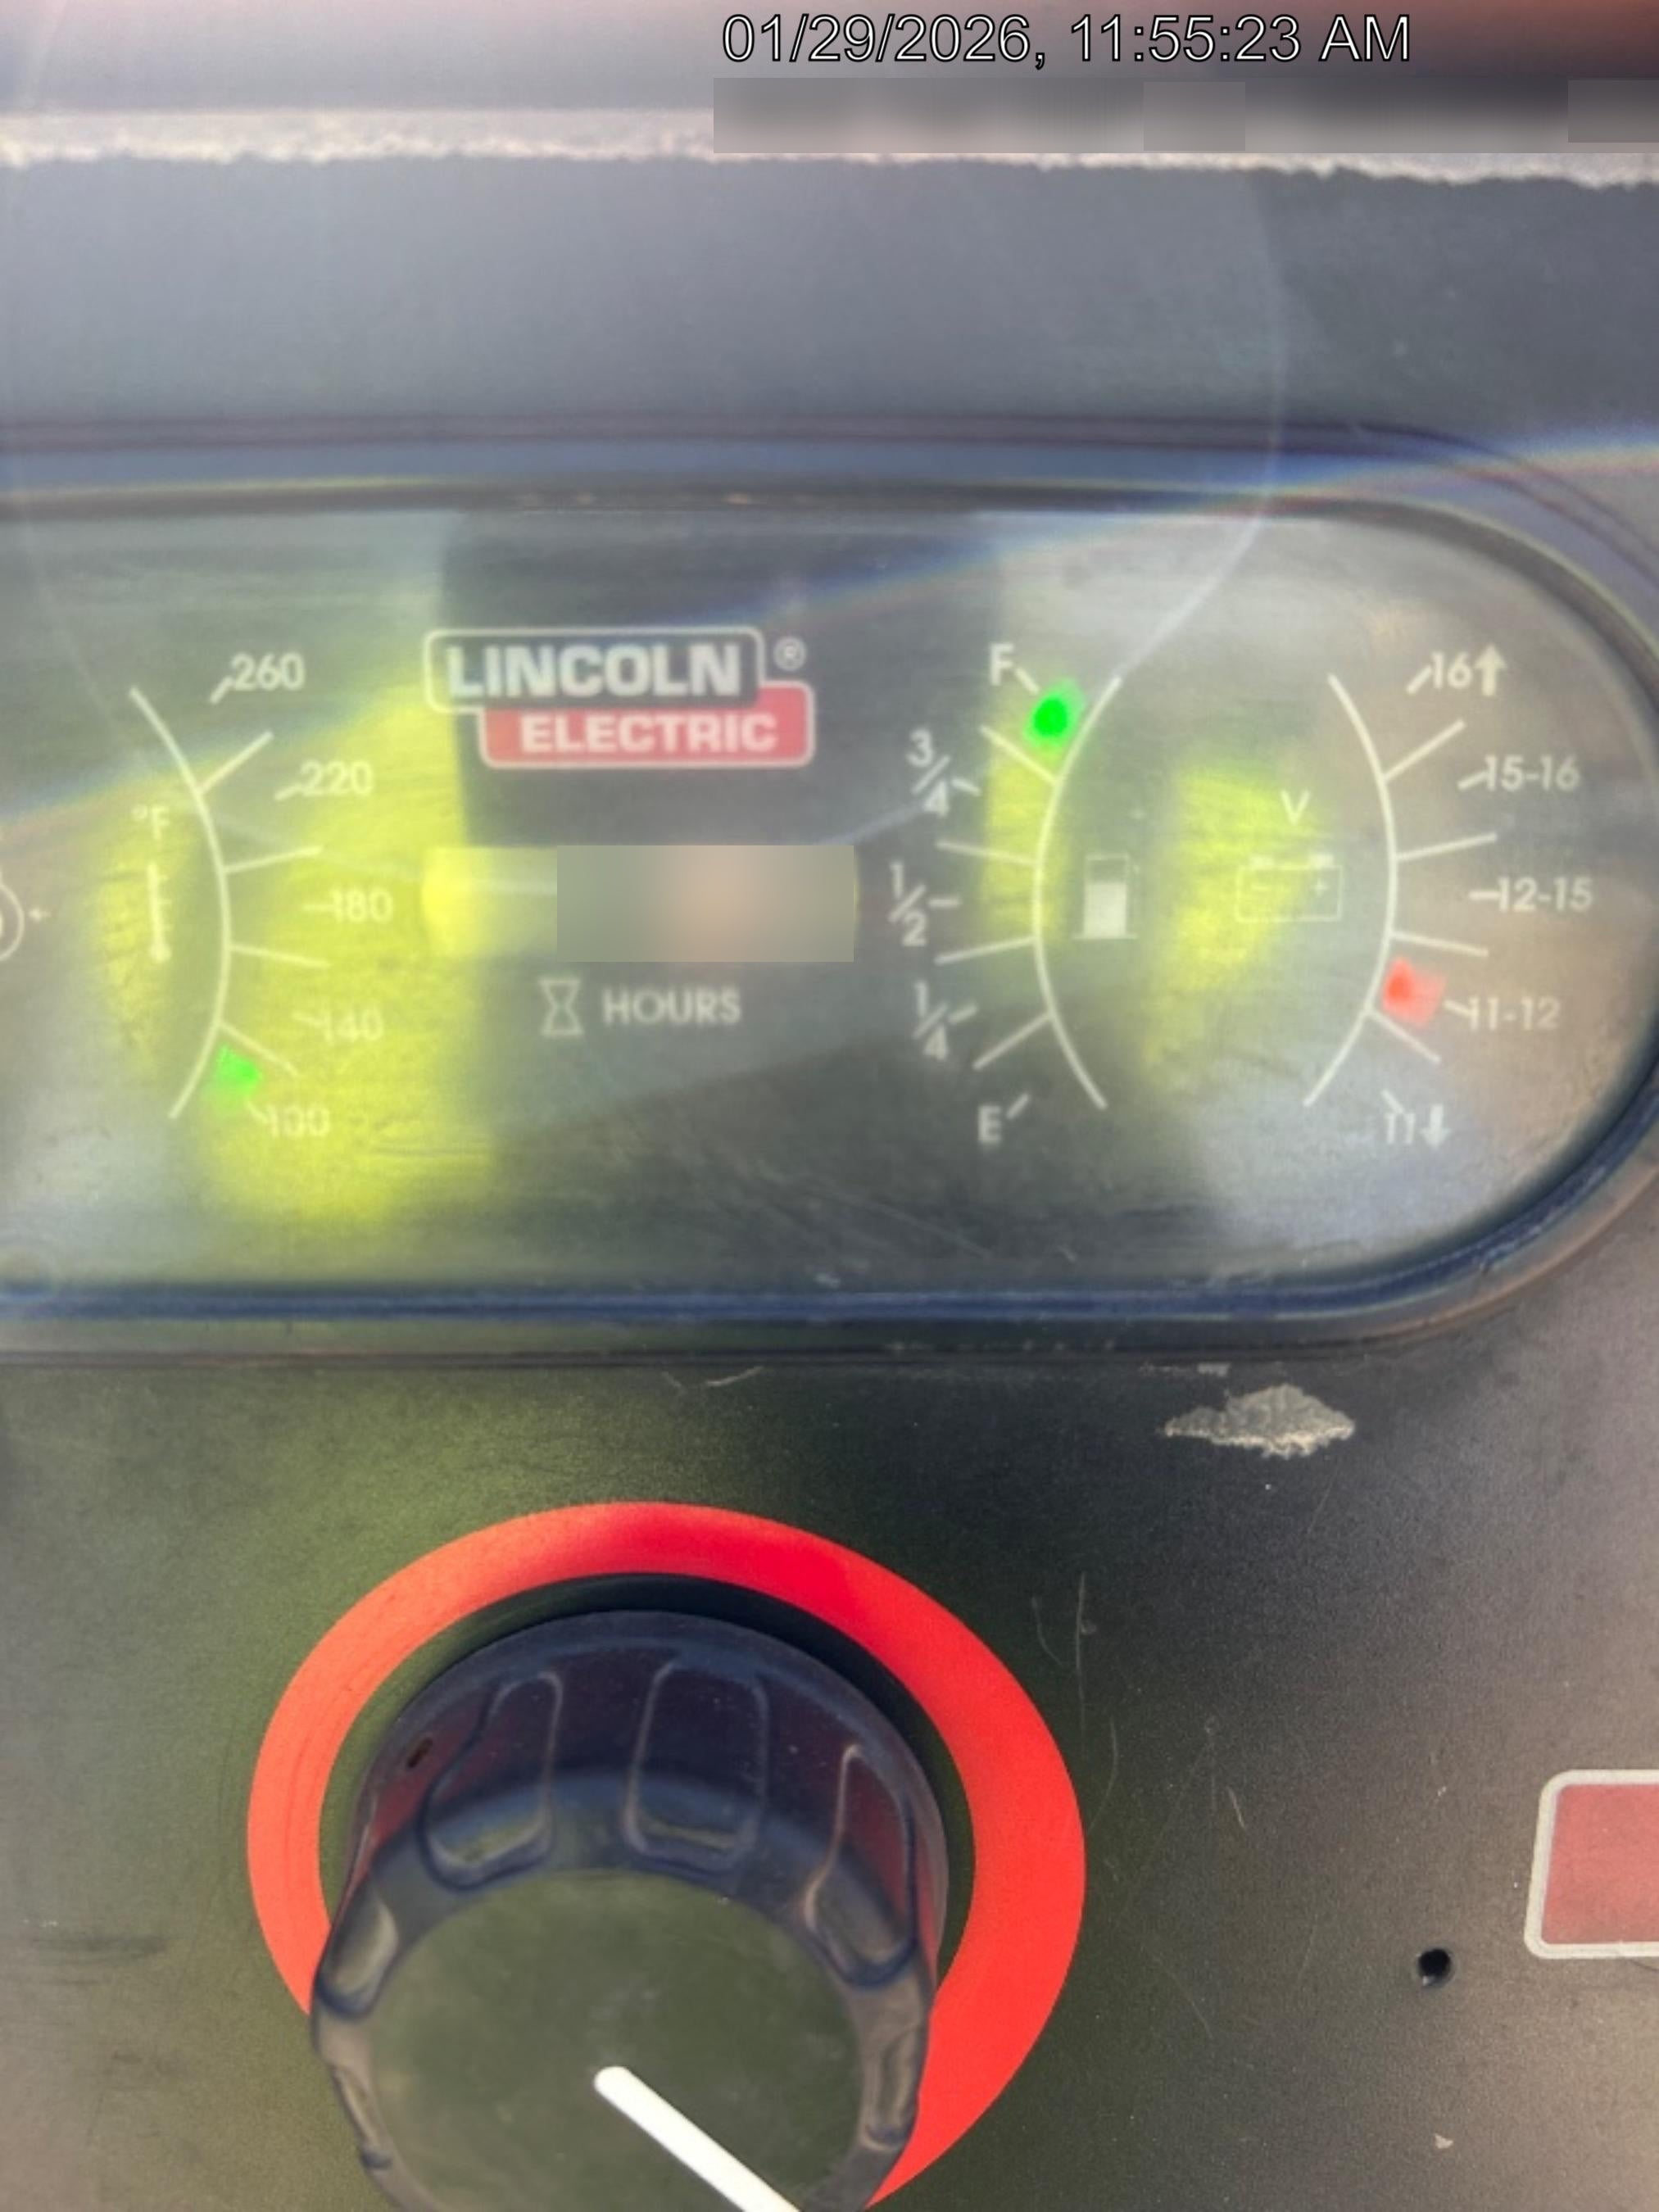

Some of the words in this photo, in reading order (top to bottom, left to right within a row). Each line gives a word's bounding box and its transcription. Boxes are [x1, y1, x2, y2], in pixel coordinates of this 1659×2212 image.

[232, 653, 306, 690] 260
[446, 643, 741, 699] LINCOLN
[990, 643, 1013, 685] F
[519, 712, 777, 754] ELECTRIC
[300, 759, 374, 797] 220
[1484, 755, 1580, 791] 15-16
[329, 888, 392, 922] 180
[1497, 877, 1593, 913] 12-15
[601, 988, 741, 1026] HOURS
[978, 1106, 1002, 1144] E
